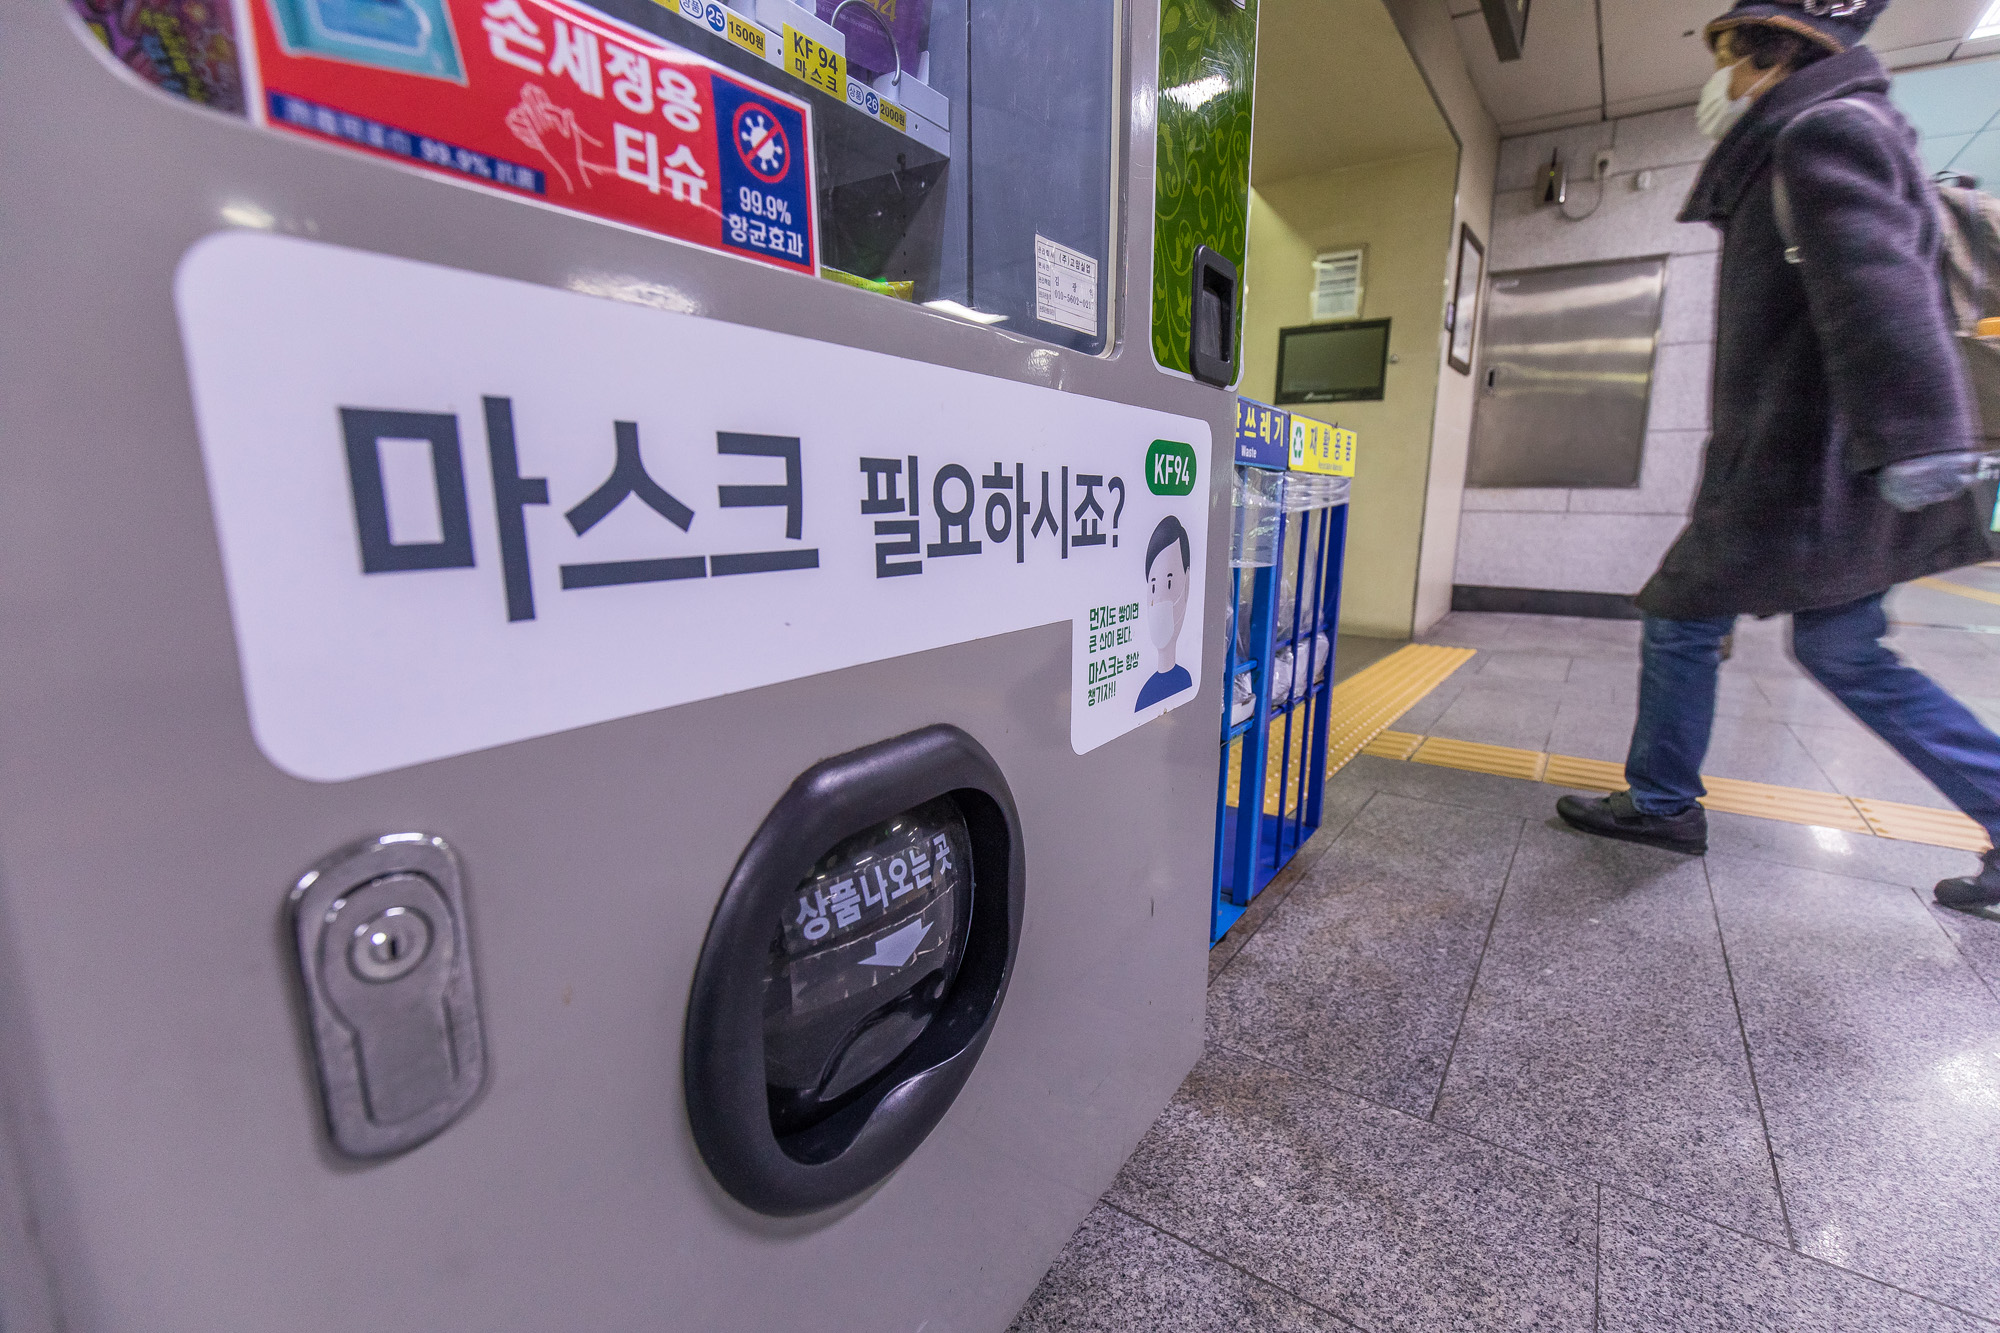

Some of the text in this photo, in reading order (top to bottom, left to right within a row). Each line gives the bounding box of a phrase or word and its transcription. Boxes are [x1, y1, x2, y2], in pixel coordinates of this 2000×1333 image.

[707, 11, 725, 28] 25
[728, 21, 764, 51] 1500원
[482, 0, 702, 133] 손세정용
[793, 31, 838, 75] KF 94
[795, 57, 839, 94] 마스크
[866, 95, 878, 111] 26
[880, 104, 905, 126] 2000원
[613, 121, 708, 207] 티슈
[739, 186, 792, 226] 99.9%
[728, 213, 804, 259] 항균효과
[1244, 406, 1284, 448] 쓰레기
[1153, 452, 1190, 486] KF94
[337, 394, 1126, 624] 마스크 필요하시죠?
[1089, 602, 1140, 632] 먼지도 쌓이면
[1089, 634, 1097, 654] 큰
[1099, 630, 1115, 651] 산이
[1088, 650, 1140, 686] 마스크는 항상
[1087, 680, 1117, 707] 챙기자!!
